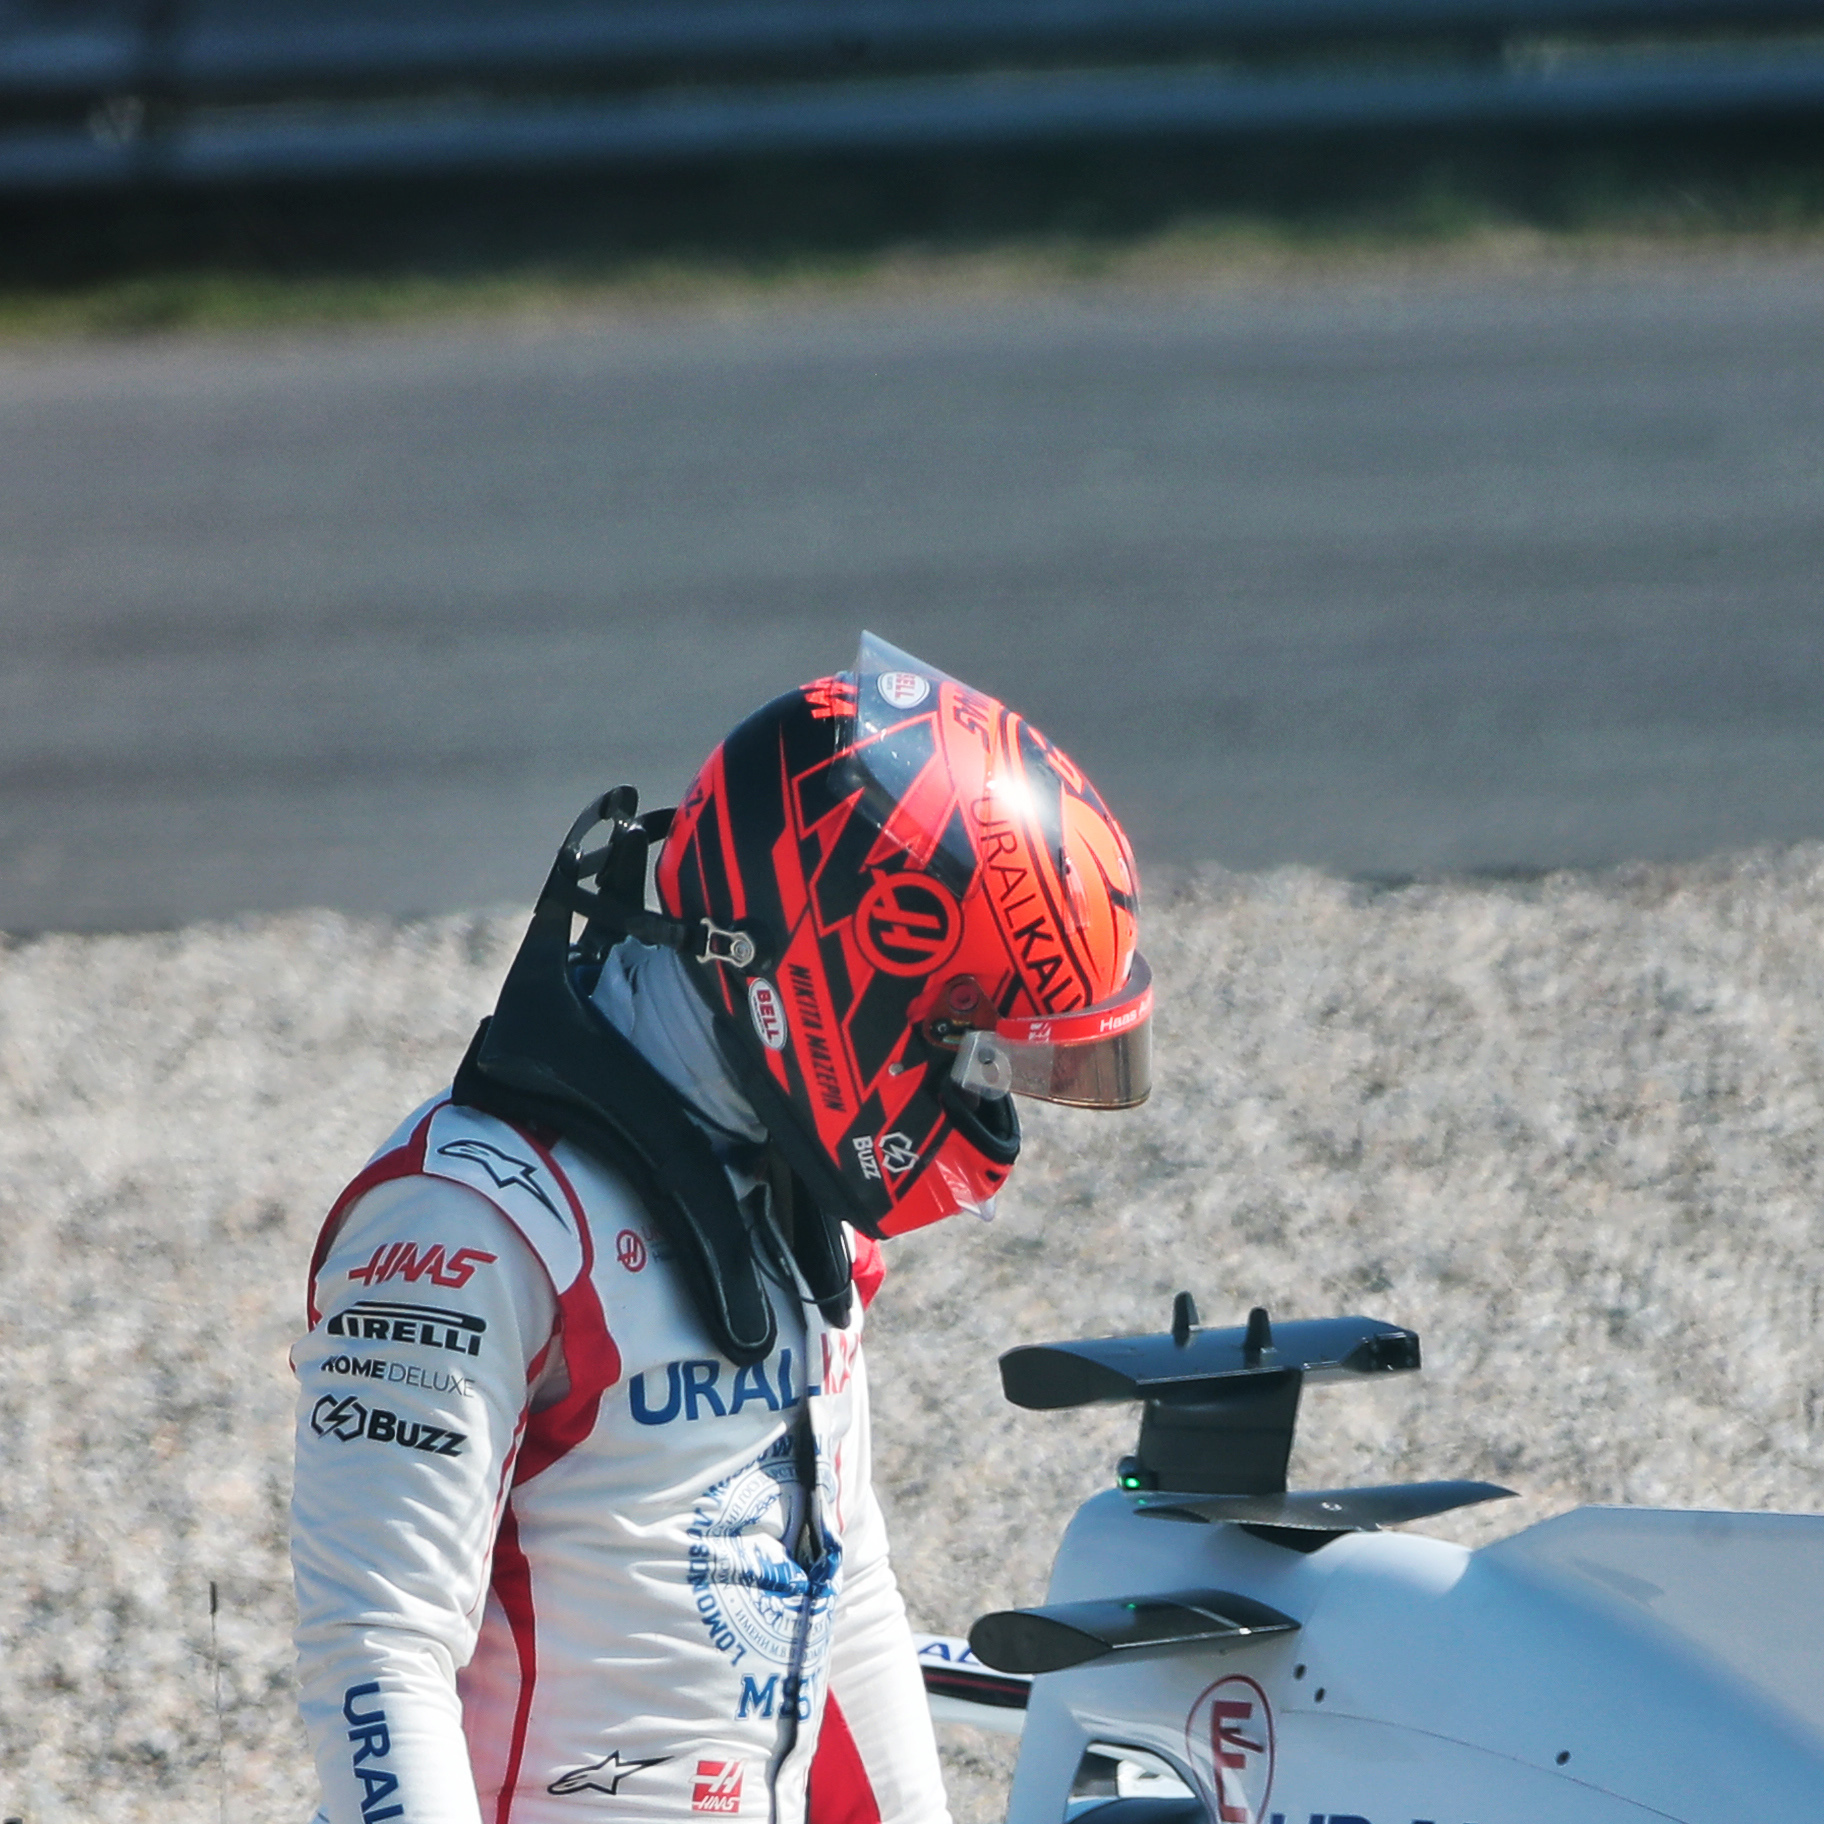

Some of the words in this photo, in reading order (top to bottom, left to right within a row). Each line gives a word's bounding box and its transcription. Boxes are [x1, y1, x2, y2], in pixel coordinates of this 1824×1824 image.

[971, 797, 1083, 1014] URALKALI
[757, 989, 780, 1045] BELL
[788, 963, 823, 1030] NIKITA
[1100, 1008, 1137, 1032] Haas
[805, 1033, 847, 1113] MAZEPIN
[853, 1135, 882, 1180] BUZZ
[347, 1241, 499, 1289] HAAS
[327, 1300, 487, 1357] PIRELLI
